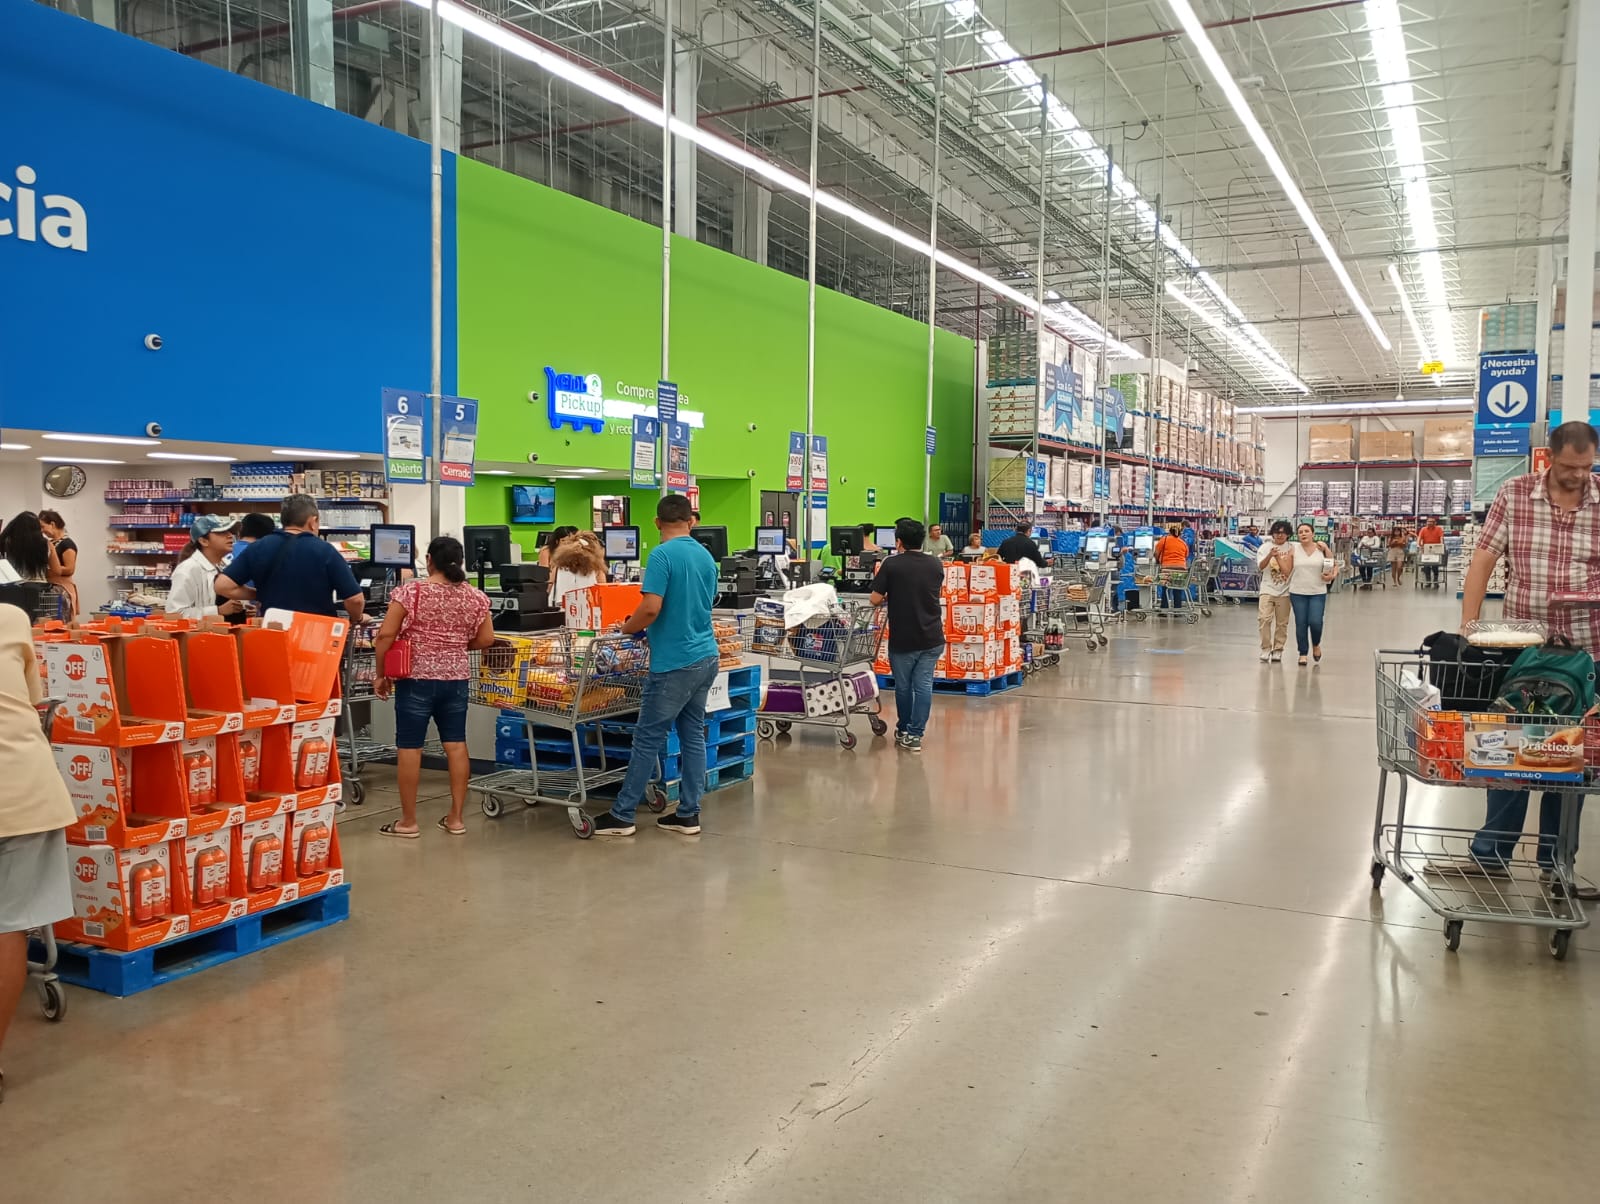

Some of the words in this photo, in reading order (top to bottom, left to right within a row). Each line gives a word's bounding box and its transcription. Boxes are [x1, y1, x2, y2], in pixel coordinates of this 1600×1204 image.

[1482, 358, 1536, 370] ¿Necesitas
[1490, 367, 1527, 378] ayuda?
[616, 380, 654, 400] Compra
[397, 396, 409, 414] 6
[561, 393, 601, 416] Pickup
[454, 404, 465, 421] 5
[645, 421, 653, 435] 4
[675, 425, 682, 439] 3
[796, 436, 801, 449] 2
[815, 440, 820, 452] 1
[390, 463, 422, 474] Abierto
[442, 465, 472, 478] Cerrado
[634, 472, 653, 481] Abierto
[668, 475, 687, 484] Cerrado
[64, 660, 87, 678] OFF!
[479, 682, 513, 698] Nesquik
[165, 728, 182, 739] OFF!
[1519, 736, 1577, 755] Prácticos
[68, 761, 93, 779] OFF!
[169, 827, 185, 838] OFF!
[74, 863, 98, 880] OFF!
[172, 923, 187, 934] OFF!
